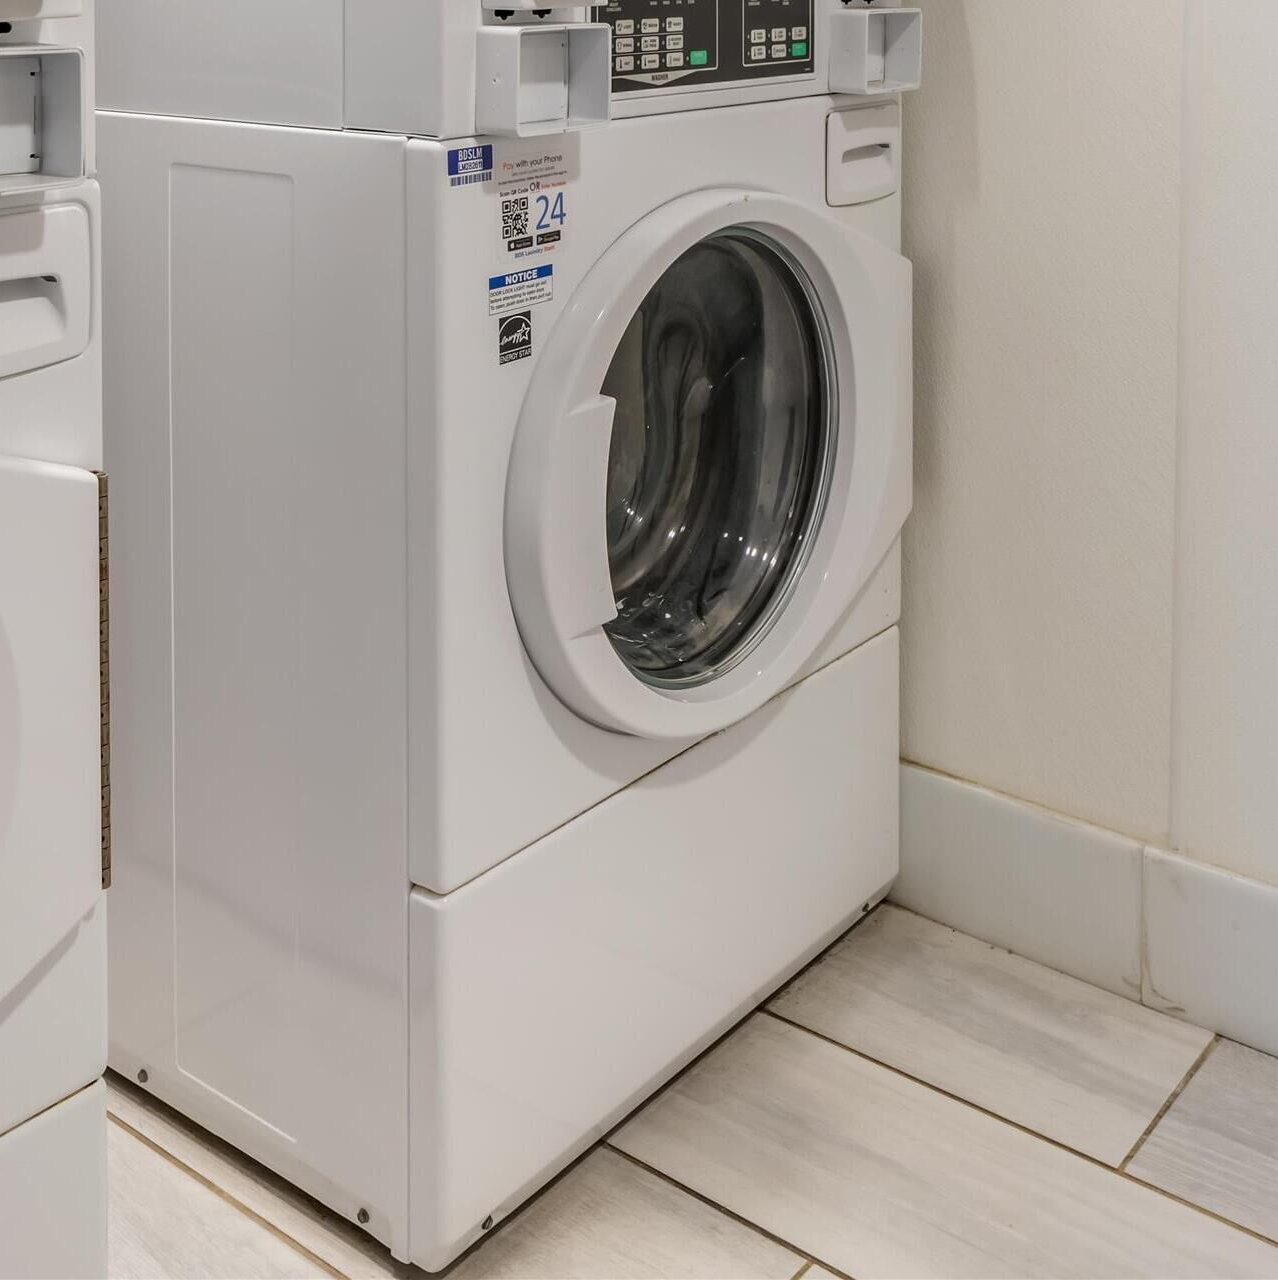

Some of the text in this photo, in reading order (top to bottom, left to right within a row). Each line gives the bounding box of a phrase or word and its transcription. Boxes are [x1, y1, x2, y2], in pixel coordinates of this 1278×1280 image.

[458, 147, 483, 161] BDSLM
[515, 159, 529, 168] with
[530, 158, 543, 168] your
[544, 154, 563, 164] Phone
[529, 181, 541, 192] OR
[536, 191, 567, 231] 24
[505, 269, 538, 285] NOTICE
[499, 348, 532, 364] ENERGY STAR
